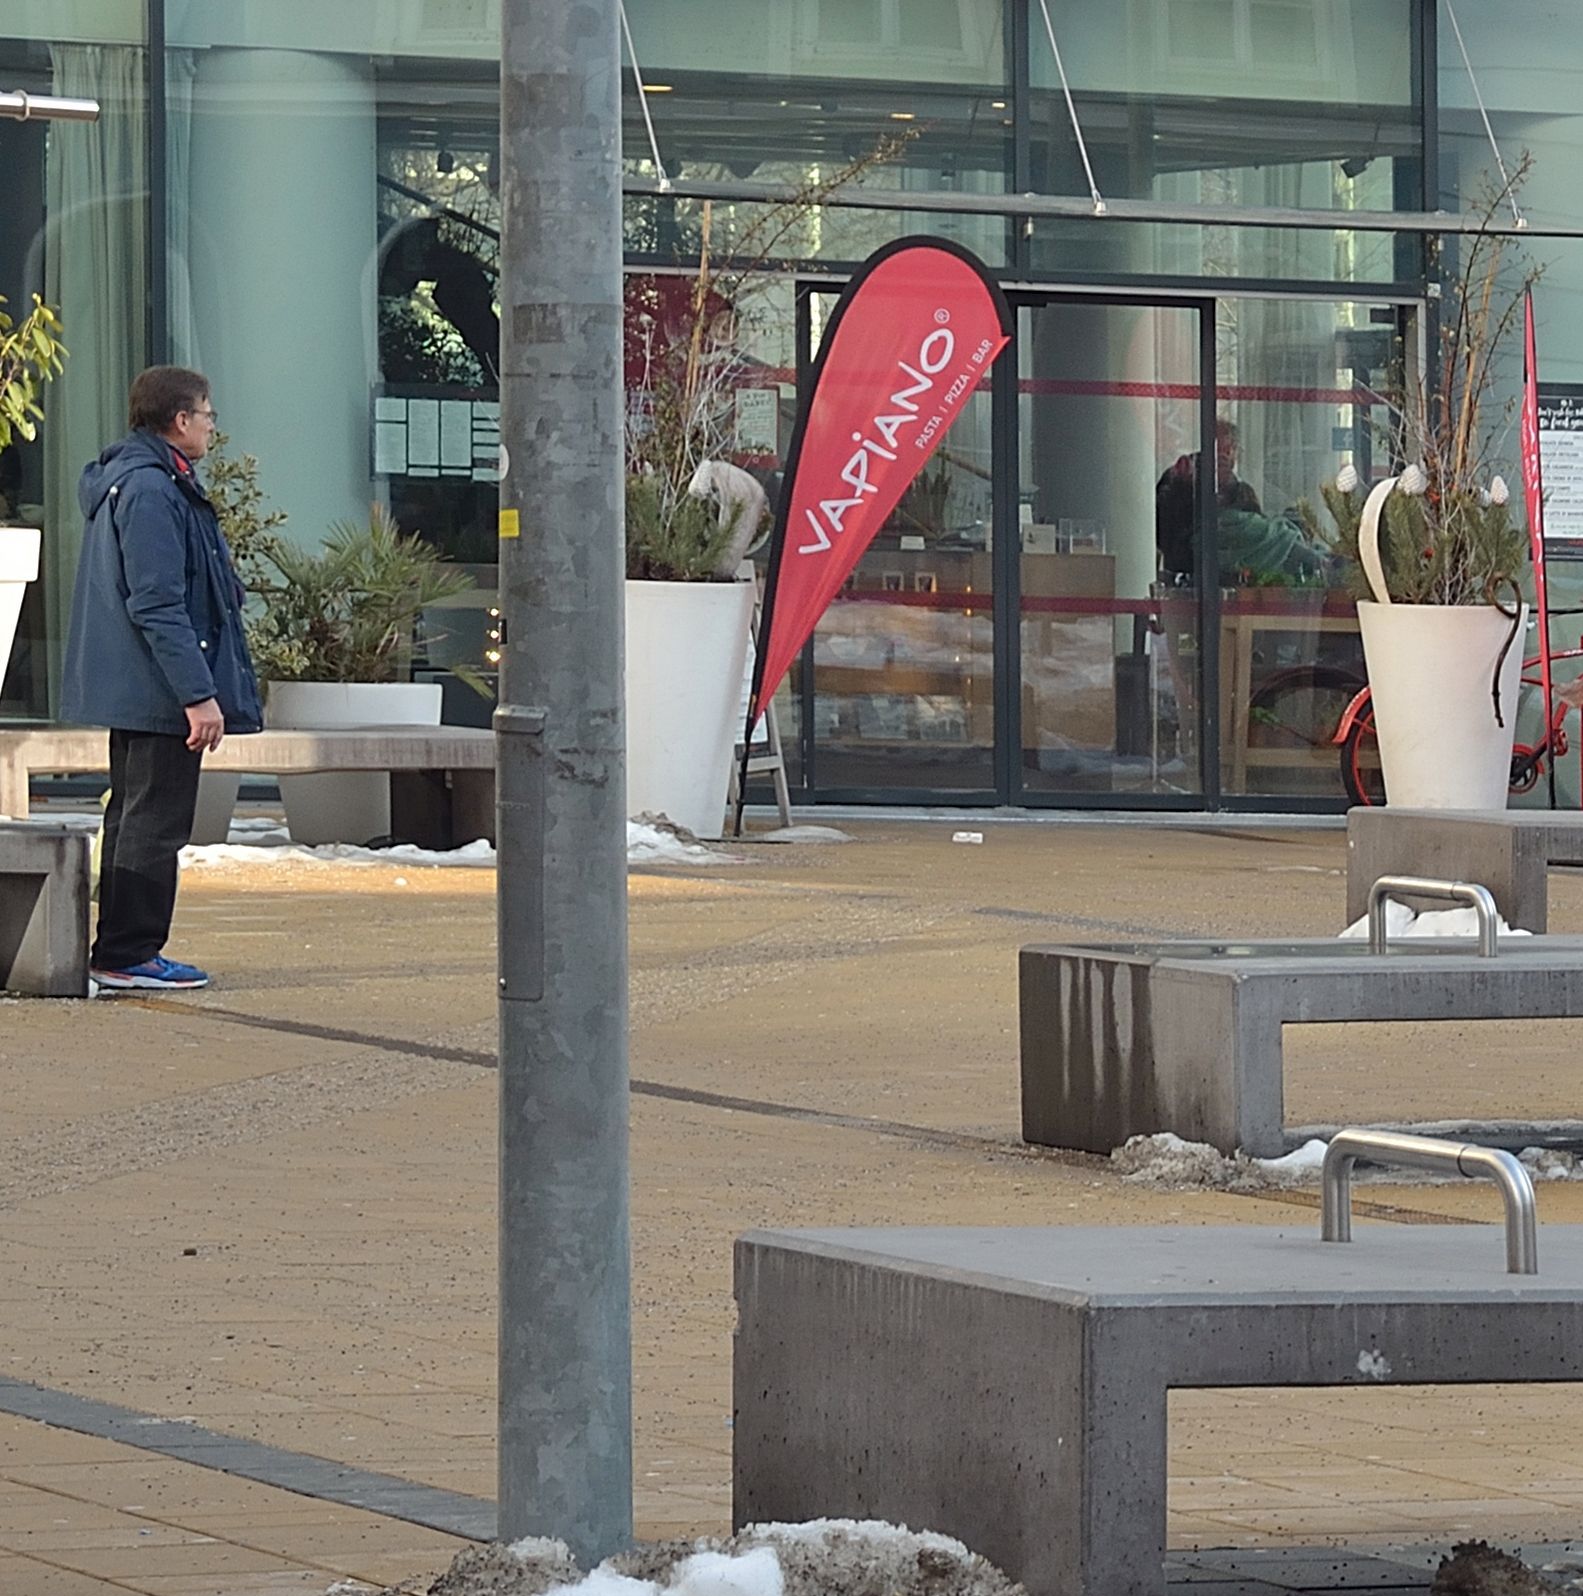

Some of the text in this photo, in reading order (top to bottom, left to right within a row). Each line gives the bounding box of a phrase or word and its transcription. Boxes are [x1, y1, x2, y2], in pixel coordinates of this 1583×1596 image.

[915, 339, 993, 449] PASTA PIZZA BAR
